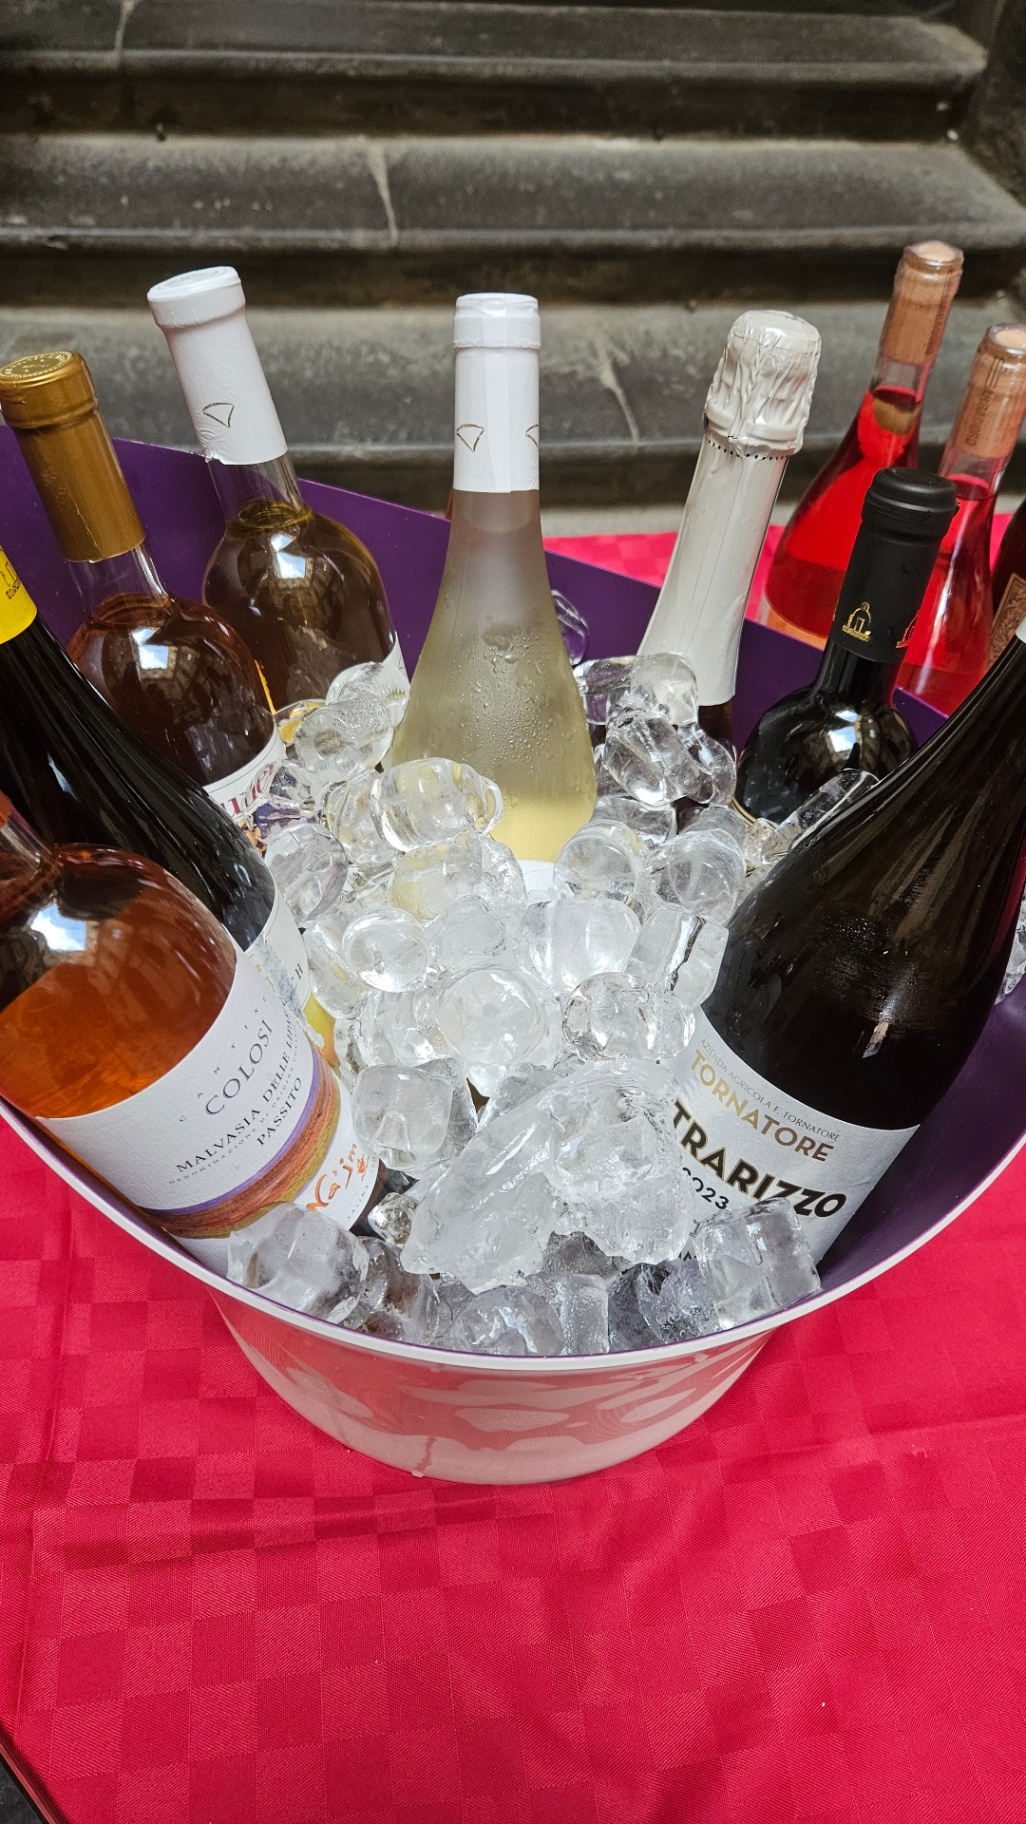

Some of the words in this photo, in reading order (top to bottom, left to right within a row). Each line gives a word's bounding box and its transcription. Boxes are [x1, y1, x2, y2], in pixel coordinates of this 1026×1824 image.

[176, 1109, 261, 1173] MALVASIA
[262, 1052, 290, 1103] DELLE
[205, 1019, 273, 1115] COLOSI
[257, 1077, 302, 1146] PASSITO
[691, 1049, 834, 1162] TORNATORE
[700, 1038, 728, 1073] AZIENDA
[728, 1071, 771, 1111] AGRICOLA
[783, 1111, 841, 1142] TORNATORE
[169, 1127, 257, 1185] DENOMINAZIONE
[260, 1113, 269, 1123] DI
